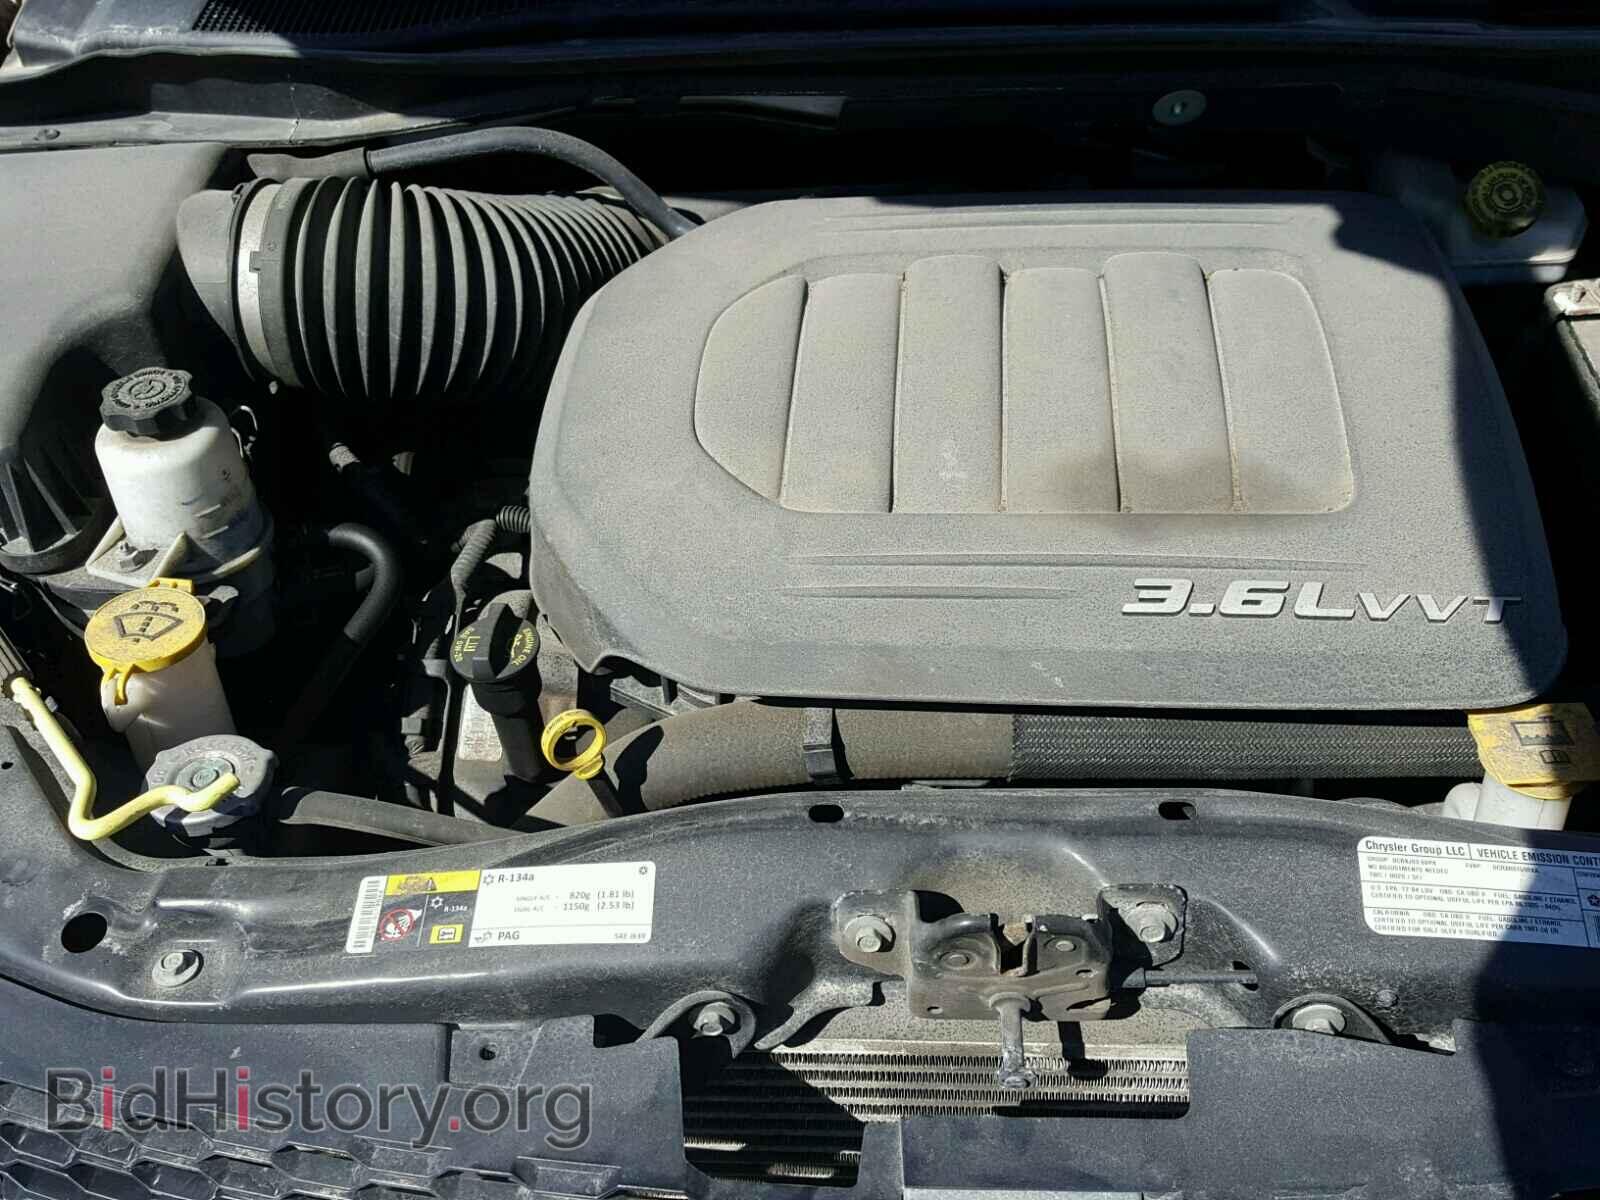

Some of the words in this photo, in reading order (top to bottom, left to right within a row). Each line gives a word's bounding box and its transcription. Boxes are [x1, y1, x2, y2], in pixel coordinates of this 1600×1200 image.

[522, 628, 536, 654] ENGINE
[511, 654, 526, 666] OIL
[1365, 840, 1407, 852] Chrysler
[1411, 844, 1442, 856] Group
[1446, 846, 1465, 856] LLC
[1476, 848, 1520, 860] VEHICLE
[1521, 852, 1569, 864] EMISSION
[1573, 855, 1600, 867] CONT
[498, 873, 535, 883] R-134a
[569, 891, 591, 900] 820g
[597, 890, 620, 899] (1.81
[622, 890, 635, 899] lb)
[564, 902, 590, 912] 1150g
[597, 902, 620, 912] (2.53
[622, 901, 635, 911] lb)
[498, 931, 520, 941] PAG
